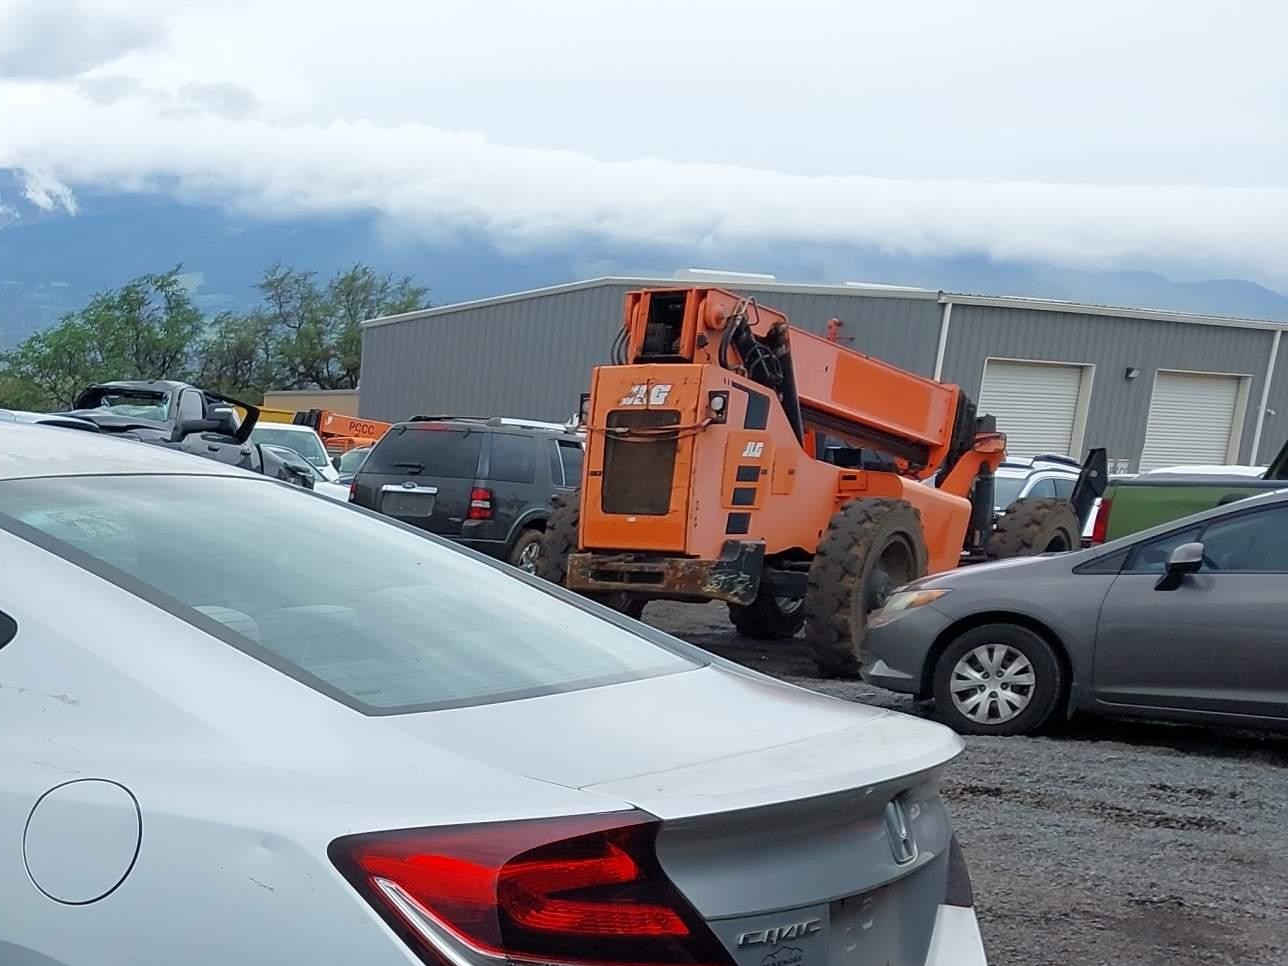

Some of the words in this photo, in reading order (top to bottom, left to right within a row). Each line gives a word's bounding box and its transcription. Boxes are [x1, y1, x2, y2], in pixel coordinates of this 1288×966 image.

[349, 421, 375, 435] PCCC
[742, 441, 765, 458] JLG
[738, 918, 823, 945] CIVIC
